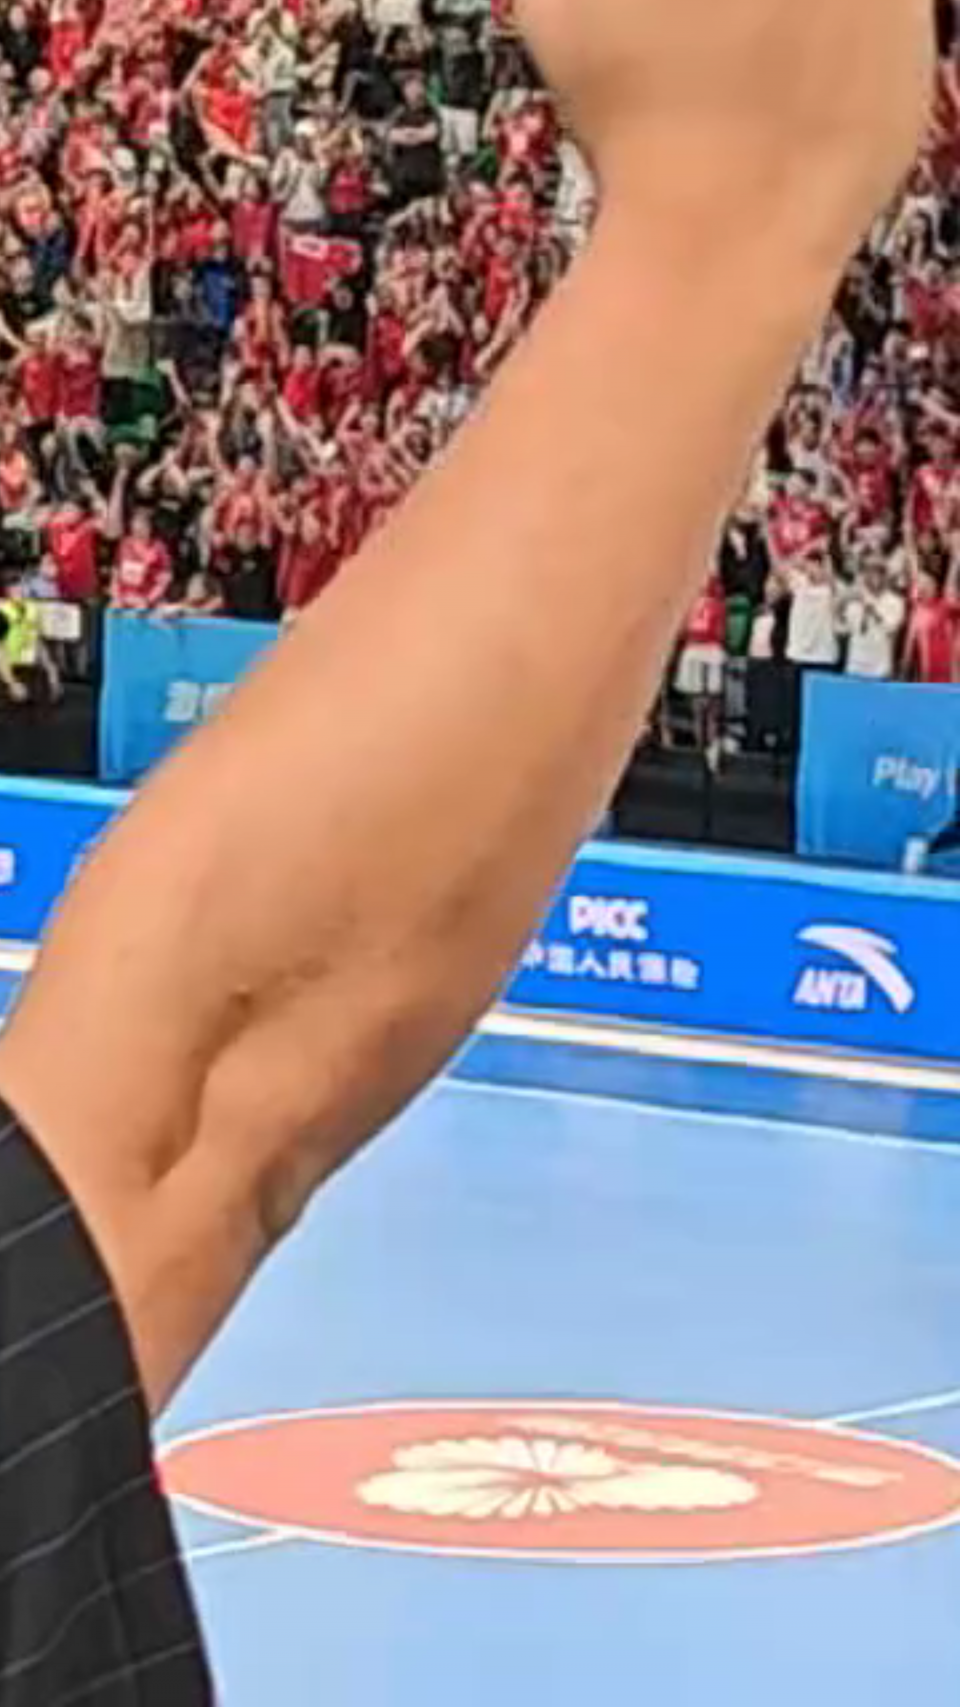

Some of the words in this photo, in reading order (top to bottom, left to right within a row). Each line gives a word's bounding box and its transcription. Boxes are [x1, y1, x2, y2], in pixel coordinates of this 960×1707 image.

[872, 755, 941, 801] Play
[569, 895, 648, 940] PICC
[792, 966, 868, 1012] ANTA
